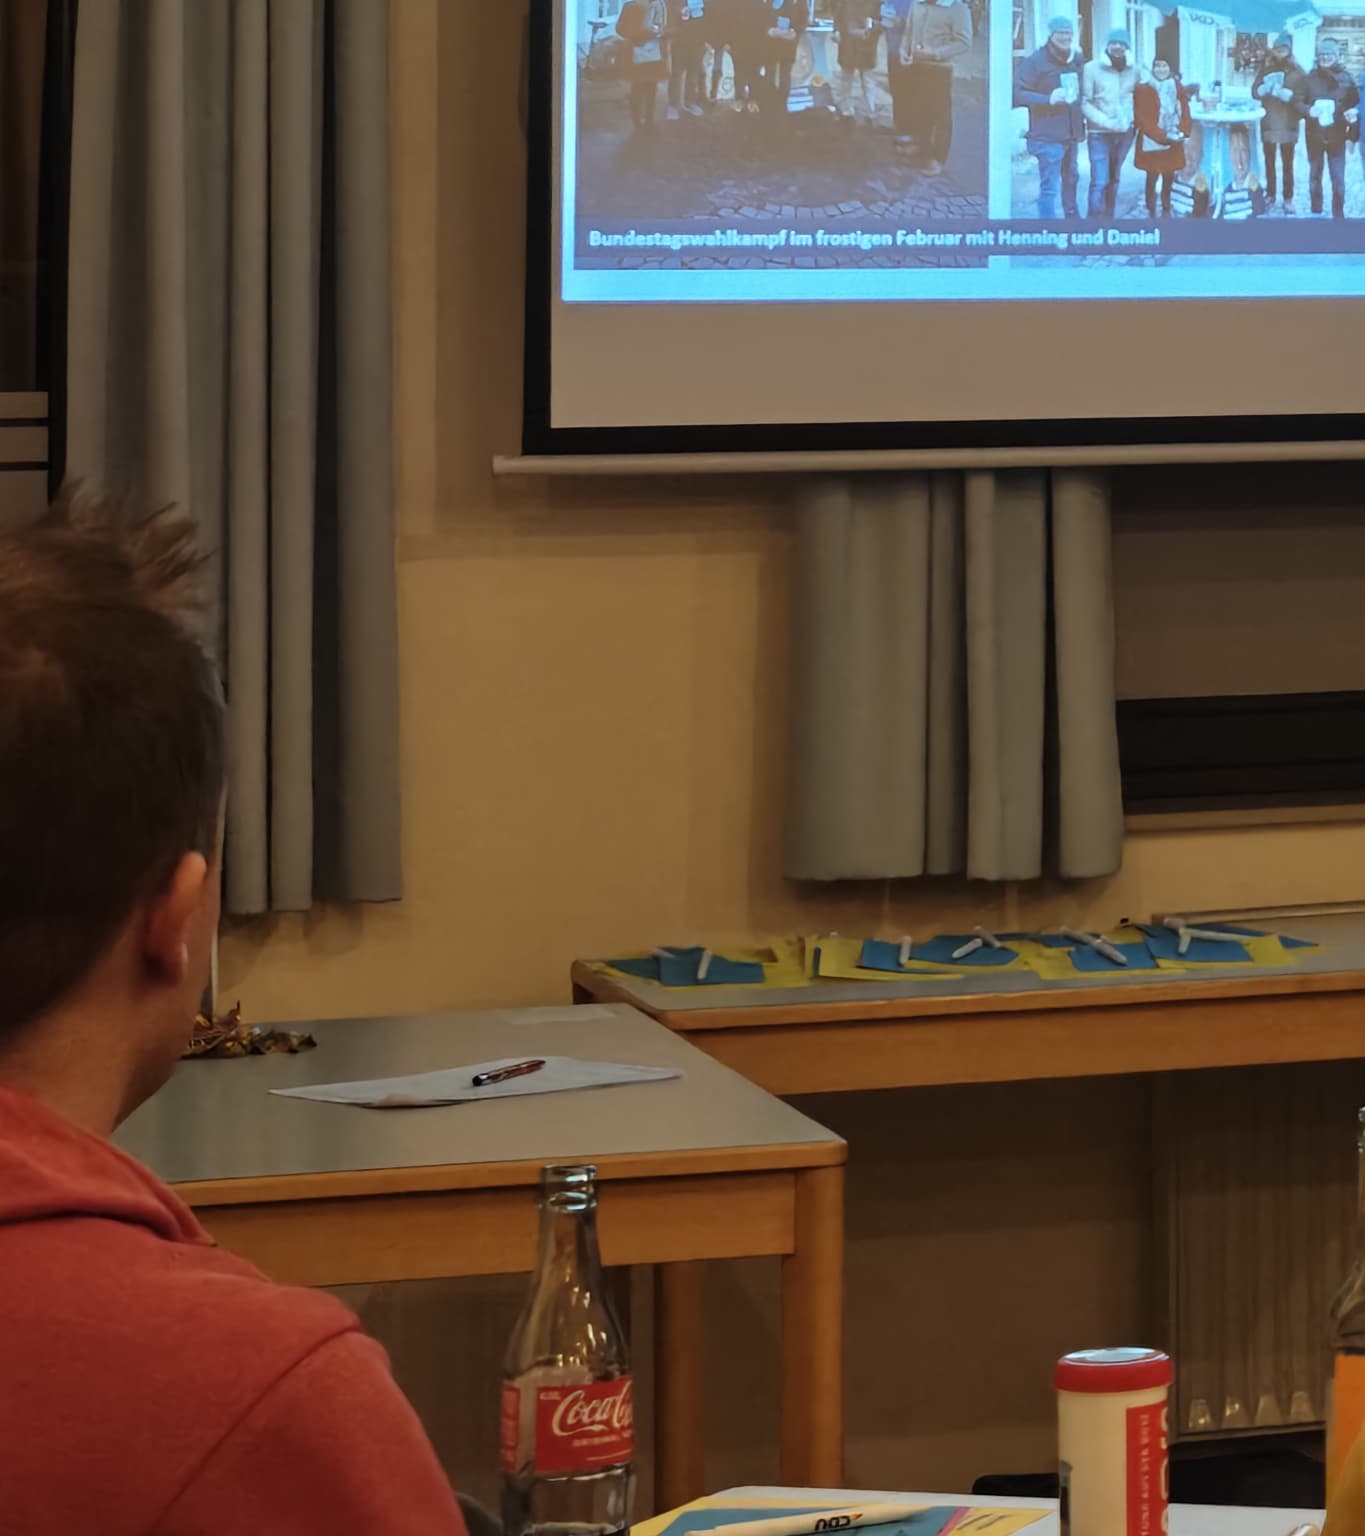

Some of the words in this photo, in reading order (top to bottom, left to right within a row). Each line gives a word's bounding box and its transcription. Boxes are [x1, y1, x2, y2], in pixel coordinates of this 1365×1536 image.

[589, 228, 788, 250] Bundestagswahlkampf
[790, 230, 812, 246] im
[815, 229, 893, 250] frostigen
[896, 229, 964, 246] Februar
[965, 230, 995, 246] mit
[999, 229, 1069, 250] Henning
[1071, 229, 1103, 246] und
[1107, 228, 1161, 246] Daniel
